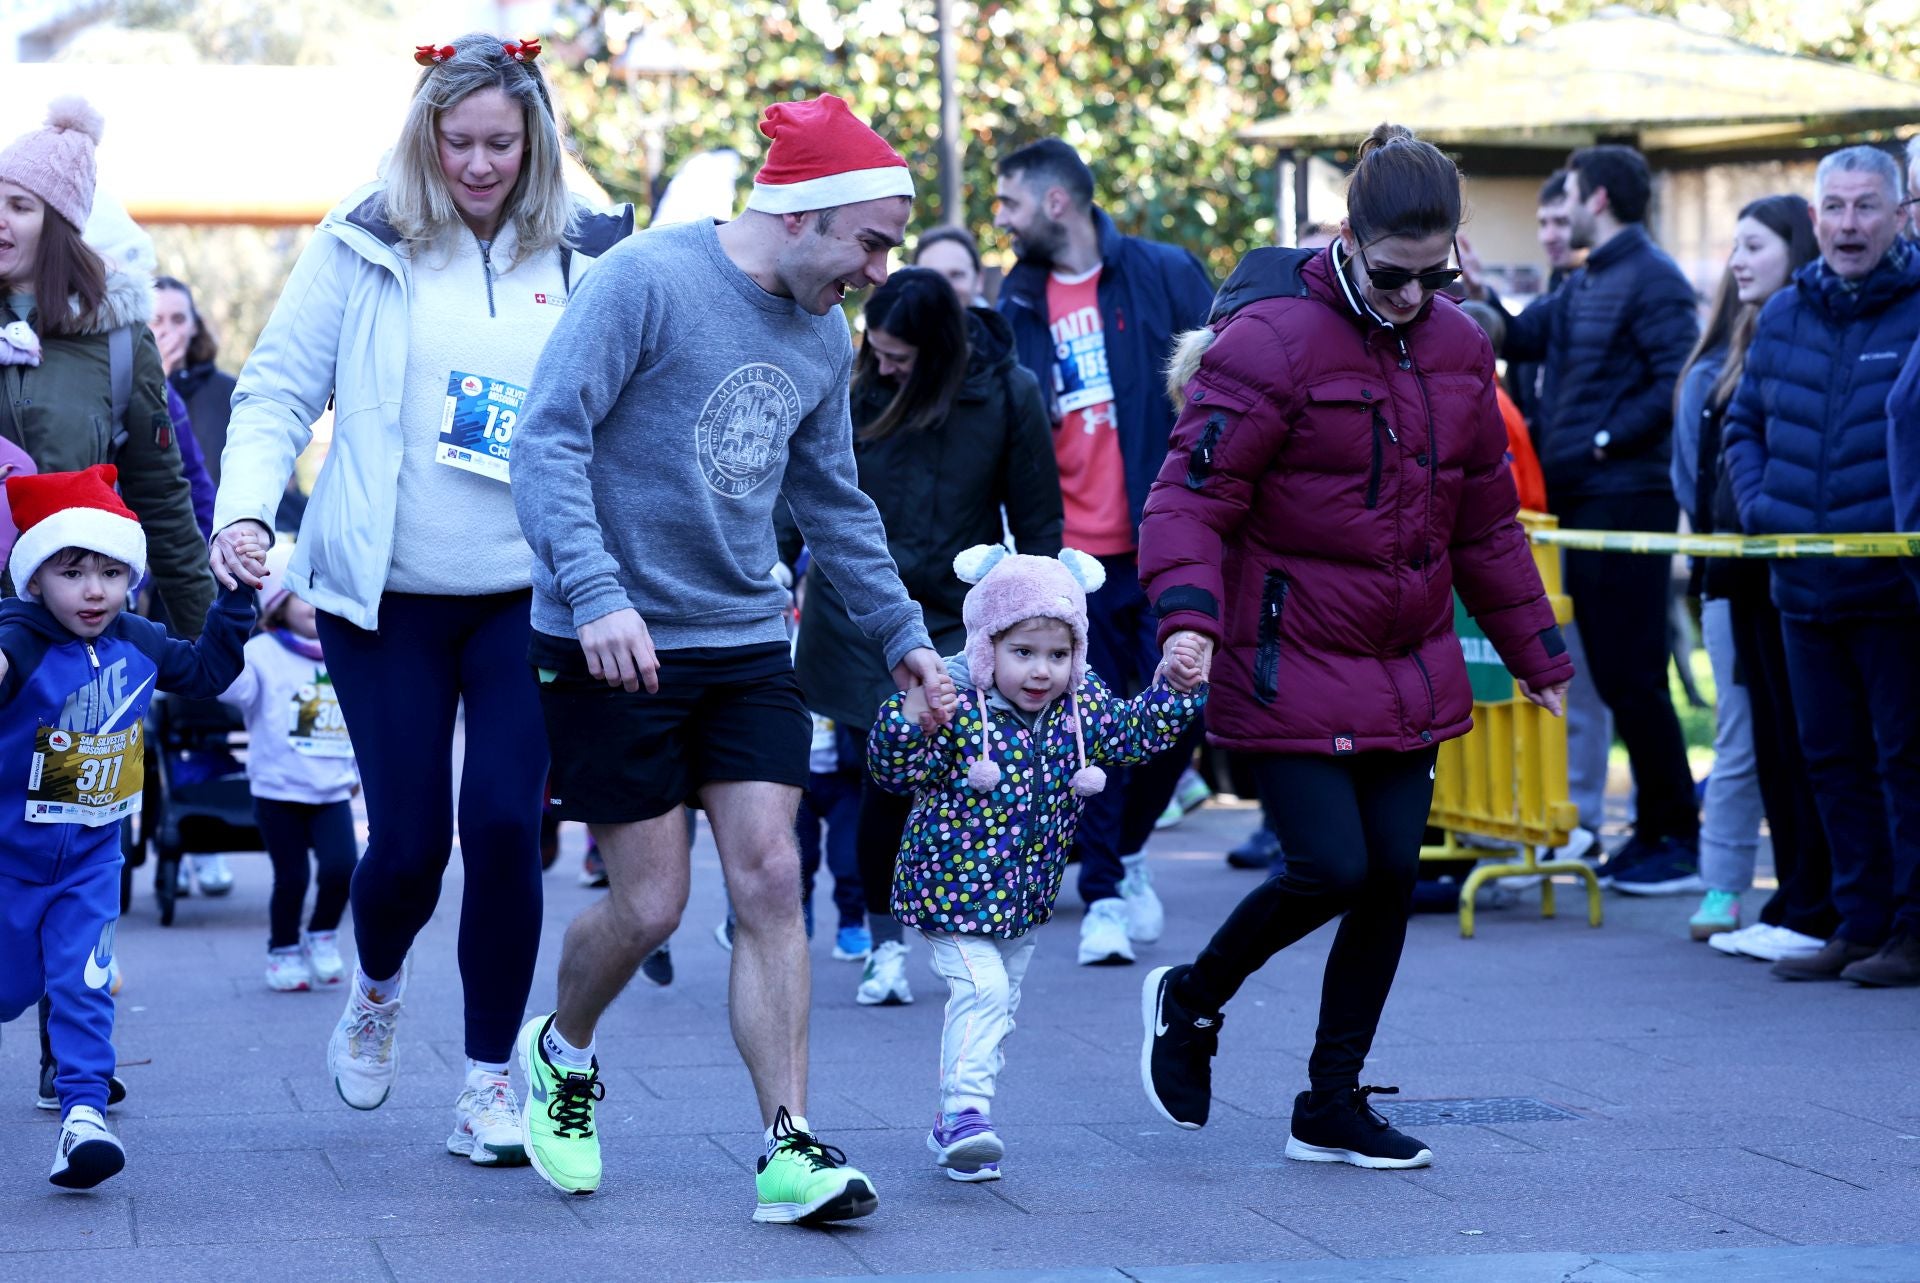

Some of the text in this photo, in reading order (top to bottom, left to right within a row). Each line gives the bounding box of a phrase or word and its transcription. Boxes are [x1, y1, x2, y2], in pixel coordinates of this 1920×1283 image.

[700, 408, 717, 455] ALMA
[718, 368, 764, 402] MATER
[58, 657, 130, 732] NIKE
[78, 744, 111, 755] MOSCONA
[80, 735, 95, 745] SAN
[76, 754, 124, 792] 311
[78, 792, 114, 805] ENZO
